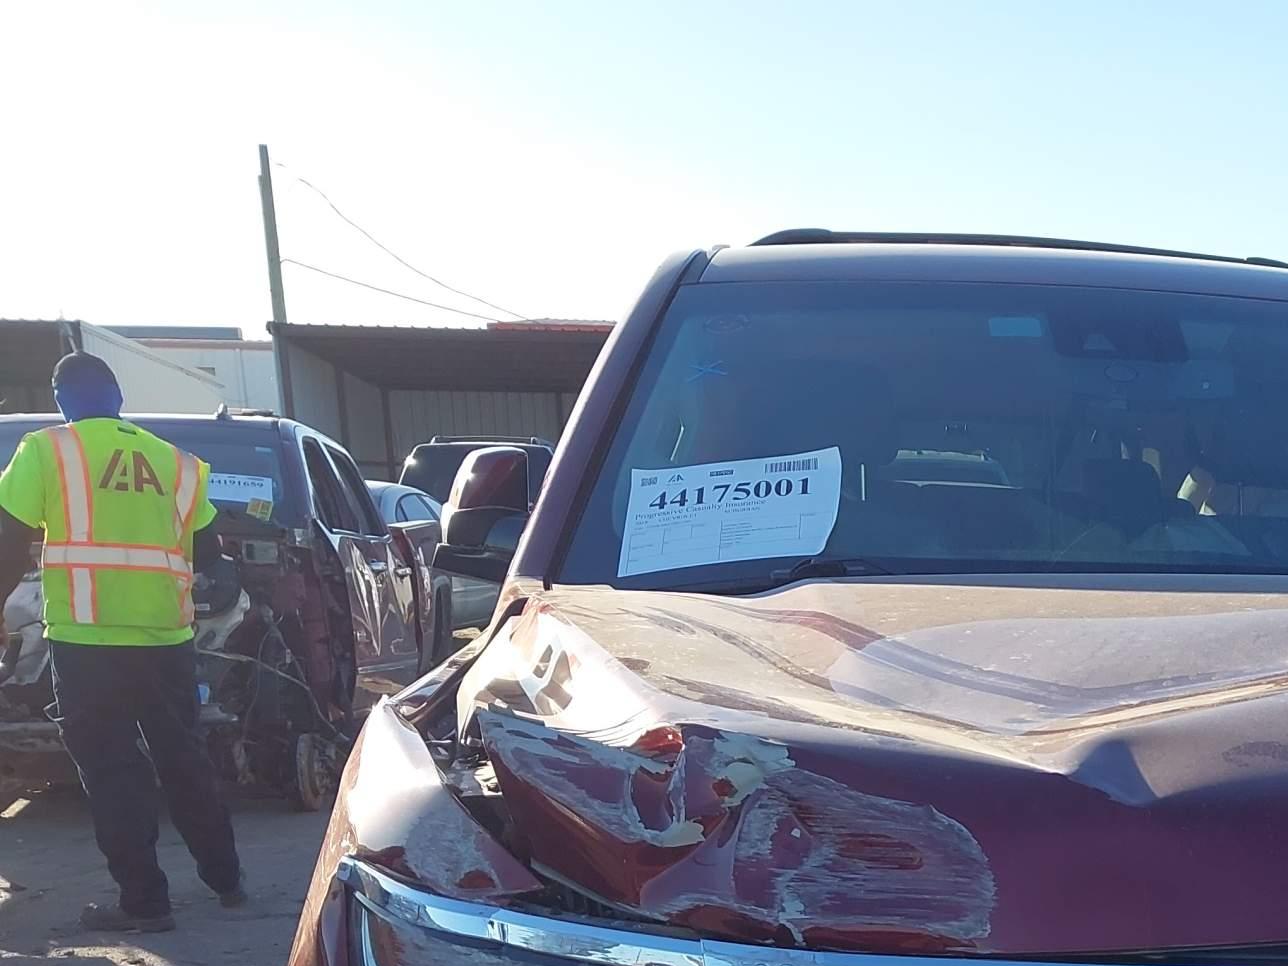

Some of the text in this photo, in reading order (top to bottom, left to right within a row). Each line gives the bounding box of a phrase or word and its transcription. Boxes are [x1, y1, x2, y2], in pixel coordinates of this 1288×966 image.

[649, 477, 813, 511] 44175001
[635, 508, 684, 521] Progressive
[686, 503, 721, 514] Casualty
